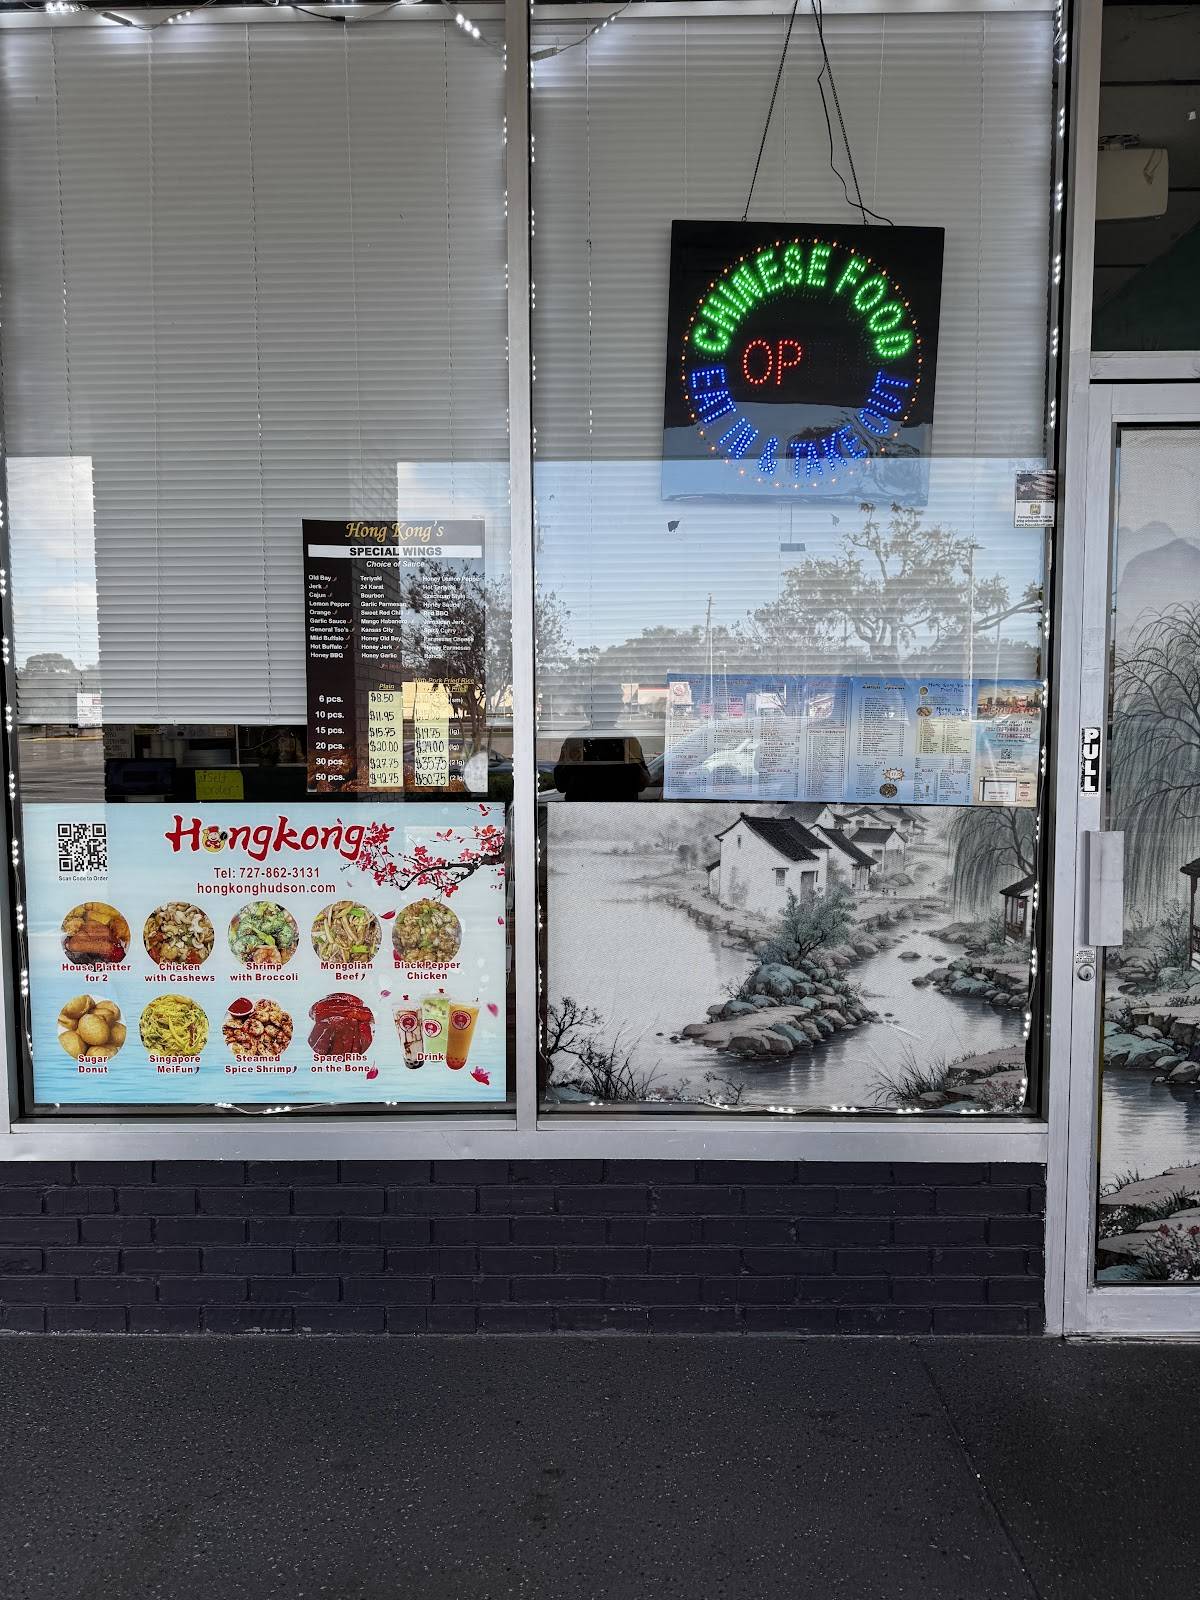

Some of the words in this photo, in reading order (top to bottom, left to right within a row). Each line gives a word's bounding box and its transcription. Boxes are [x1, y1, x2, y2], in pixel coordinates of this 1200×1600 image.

[694, 246, 830, 350] CHINESE
[835, 258, 912, 358] FOOD
[692, 369, 736, 423] EAT
[720, 418, 758, 458] IN
[790, 426, 866, 478] TAKE
[860, 372, 908, 434] OUT
[345, 521, 387, 542] Hong
[391, 520, 444, 542] Kong's
[350, 547, 400, 556] SPECIAL
[403, 547, 442, 556] WINGS
[366, 560, 391, 568] Choice
[327, 696, 344, 704] pcs.
[370, 692, 394, 703] $8.50
[328, 712, 344, 720] pcs.
[370, 711, 394, 722] $11.95
[370, 727, 396, 738] $15.75
[316, 742, 326, 750] 20
[370, 740, 398, 752] $20.00
[328, 758, 344, 766] pcs.
[370, 758, 400, 769] $27.75
[1083, 728, 1100, 792] PULL
[328, 774, 345, 782] pcs.
[370, 772, 399, 785] $42.75
[214, 867, 236, 878] Tel:
[240, 867, 320, 878] 727-862-3131
[198, 882, 336, 896] hongkonghudson.com
[62, 963, 93, 972] House
[96, 963, 131, 972] Platter
[159, 962, 200, 971] Chicken
[246, 962, 282, 972] Shrimp
[320, 962, 373, 971] Mongolian
[394, 961, 423, 969] Black
[425, 961, 461, 970] Pepper
[85, 974, 101, 982] for
[102, 974, 108, 982] 2
[144, 974, 167, 982] with
[170, 974, 216, 982] Cashews
[256, 973, 298, 981] Broccoli
[336, 972, 359, 980] Beef
[406, 972, 448, 980] Chicken
[78, 1054, 108, 1065] Sugar
[150, 1054, 200, 1065] Singapore
[236, 1054, 281, 1062] Steamed
[314, 1054, 343, 1064] Spare
[346, 1053, 368, 1062] Ribs
[418, 1052, 444, 1061] Drink
[78, 1066, 108, 1074] Donut
[157, 1066, 194, 1074] MeiFun
[225, 1066, 254, 1074] Spice
[256, 1066, 292, 1074] Shrimp
[326, 1064, 342, 1072] the
[345, 1064, 370, 1072] Bone
